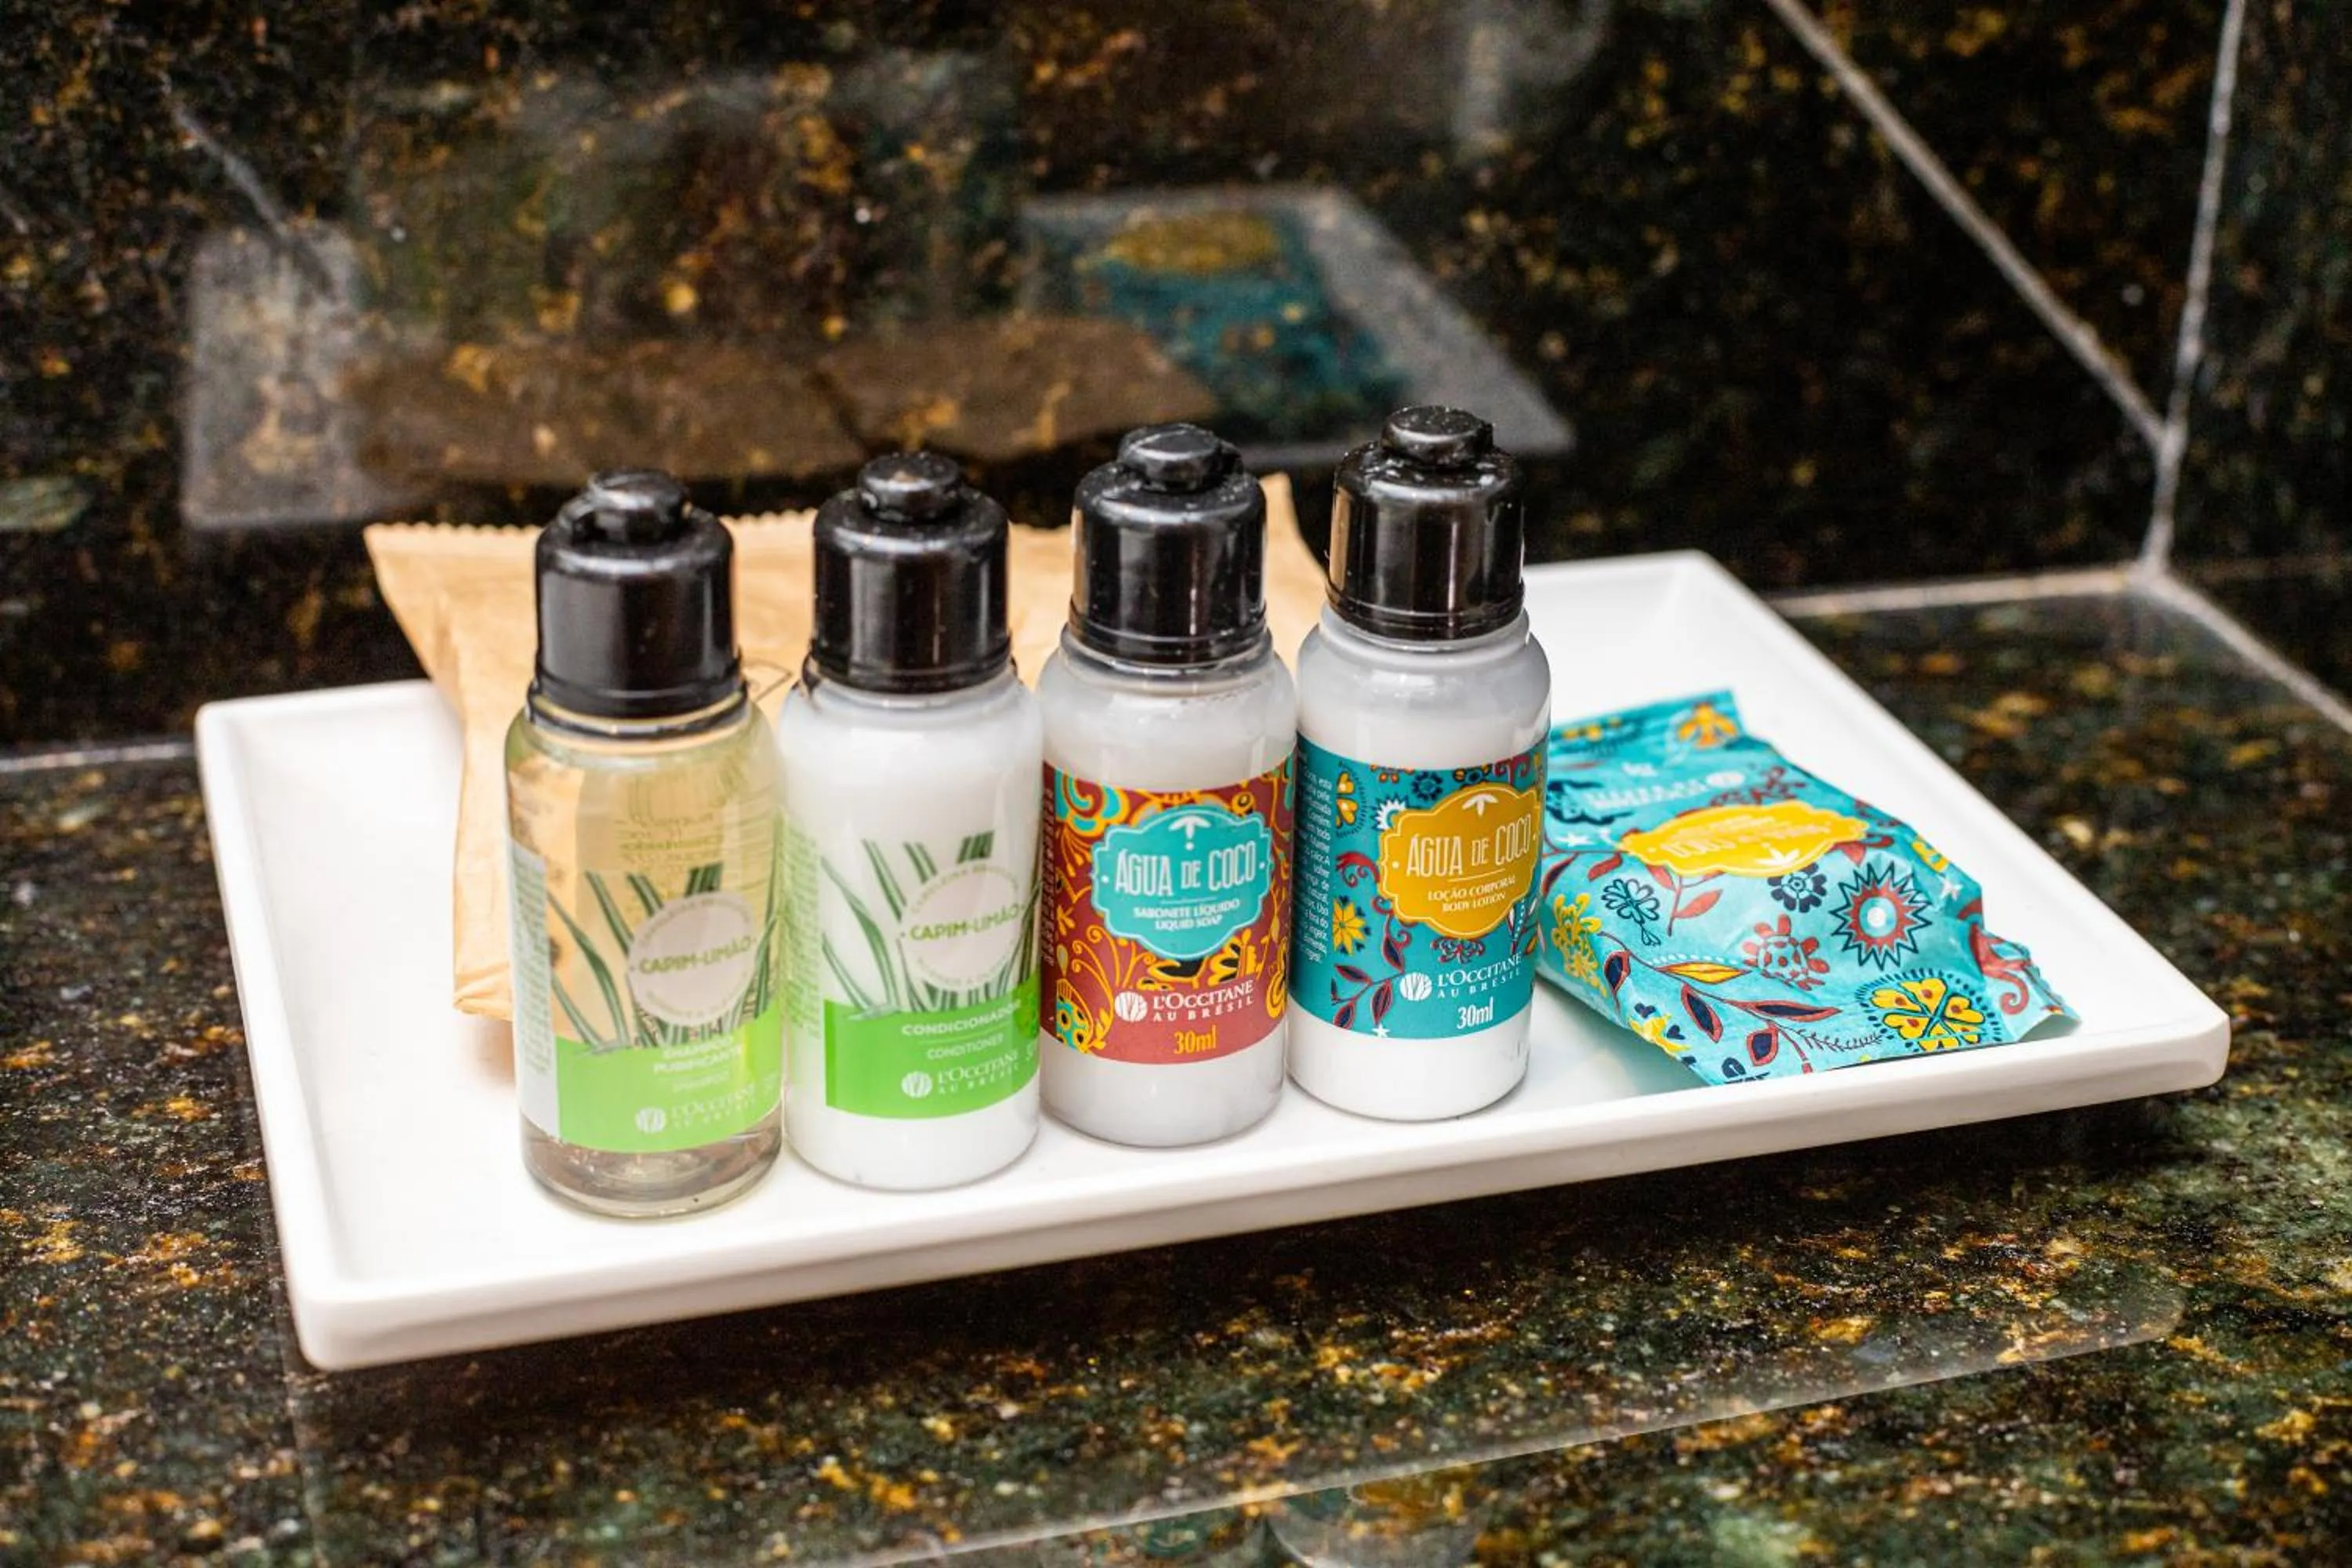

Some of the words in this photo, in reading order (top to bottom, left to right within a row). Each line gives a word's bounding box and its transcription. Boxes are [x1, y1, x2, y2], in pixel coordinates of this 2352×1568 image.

[1406, 833, 1464, 878] ÁGUA
[1471, 837, 1490, 866] DE
[1494, 812, 1531, 866] COCO
[1115, 848, 1174, 896] ÁGUA
[1180, 859, 1202, 889] DE
[1208, 840, 1257, 891] COCO
[1427, 887, 1468, 902] LOÇÃO
[1442, 901, 1470, 913] BODY
[1472, 891, 1506, 909] LOTION
[909, 902, 1020, 940] CAPIM-LIMÃO
[1133, 906, 1191, 919] SABONETE
[1154, 916, 1195, 932] LIQUID
[1196, 914, 1224, 929] SOAP
[1437, 987, 1459, 999] AU
[1152, 1011, 1177, 1023] AU
[1457, 996, 1494, 1029] 30ml
[1173, 1024, 1217, 1054] 30ml
